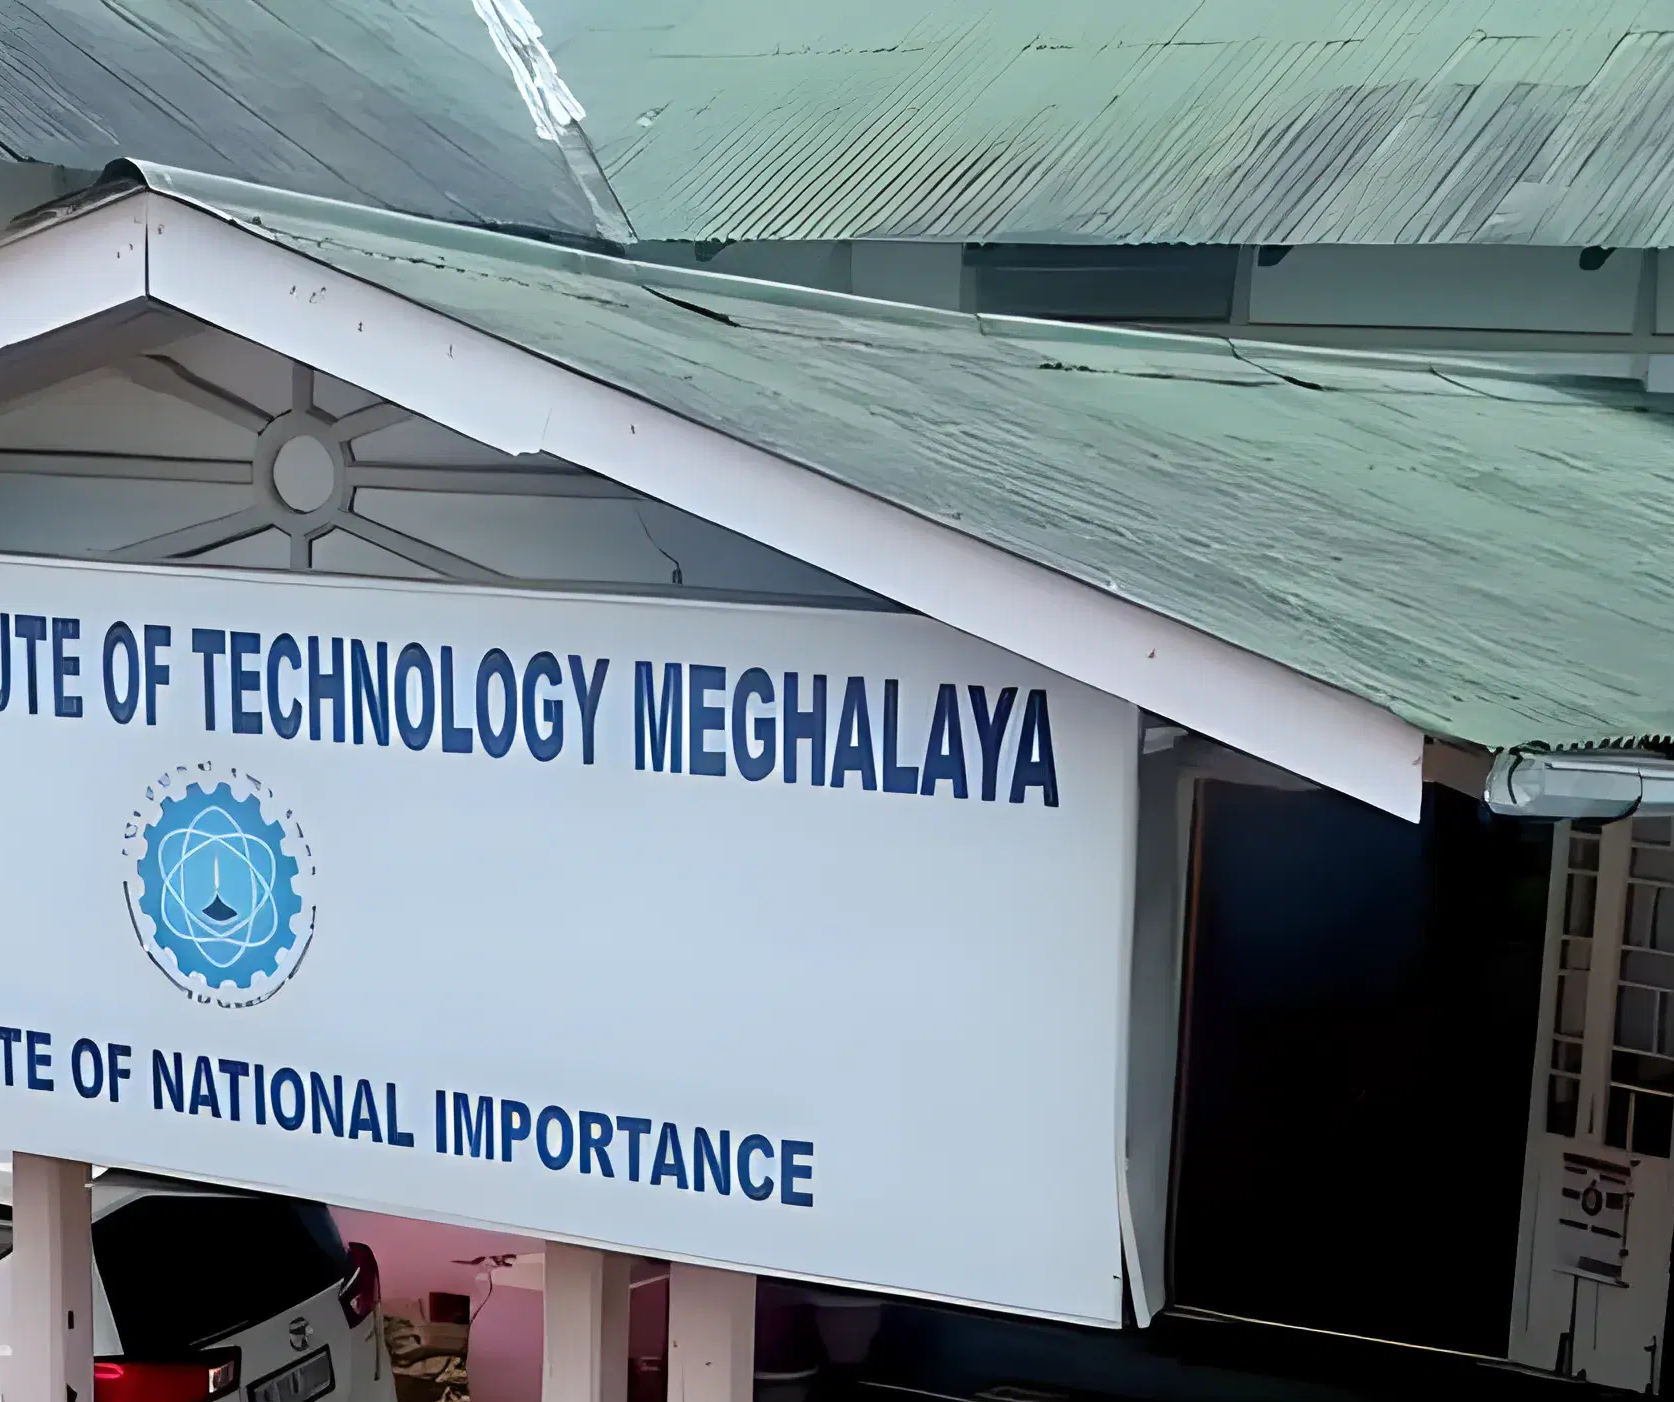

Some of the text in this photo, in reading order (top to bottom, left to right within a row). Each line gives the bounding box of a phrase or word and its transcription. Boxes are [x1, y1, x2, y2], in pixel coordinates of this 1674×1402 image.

[102, 620, 172, 726] OF
[191, 626, 610, 766] TECHNOLOGY
[634, 660, 1060, 808] MEGHALAYA
[71, 1037, 132, 1103] OF
[152, 1048, 415, 1148] NATIONAL
[435, 1089, 815, 1209] IMPORTANCE
